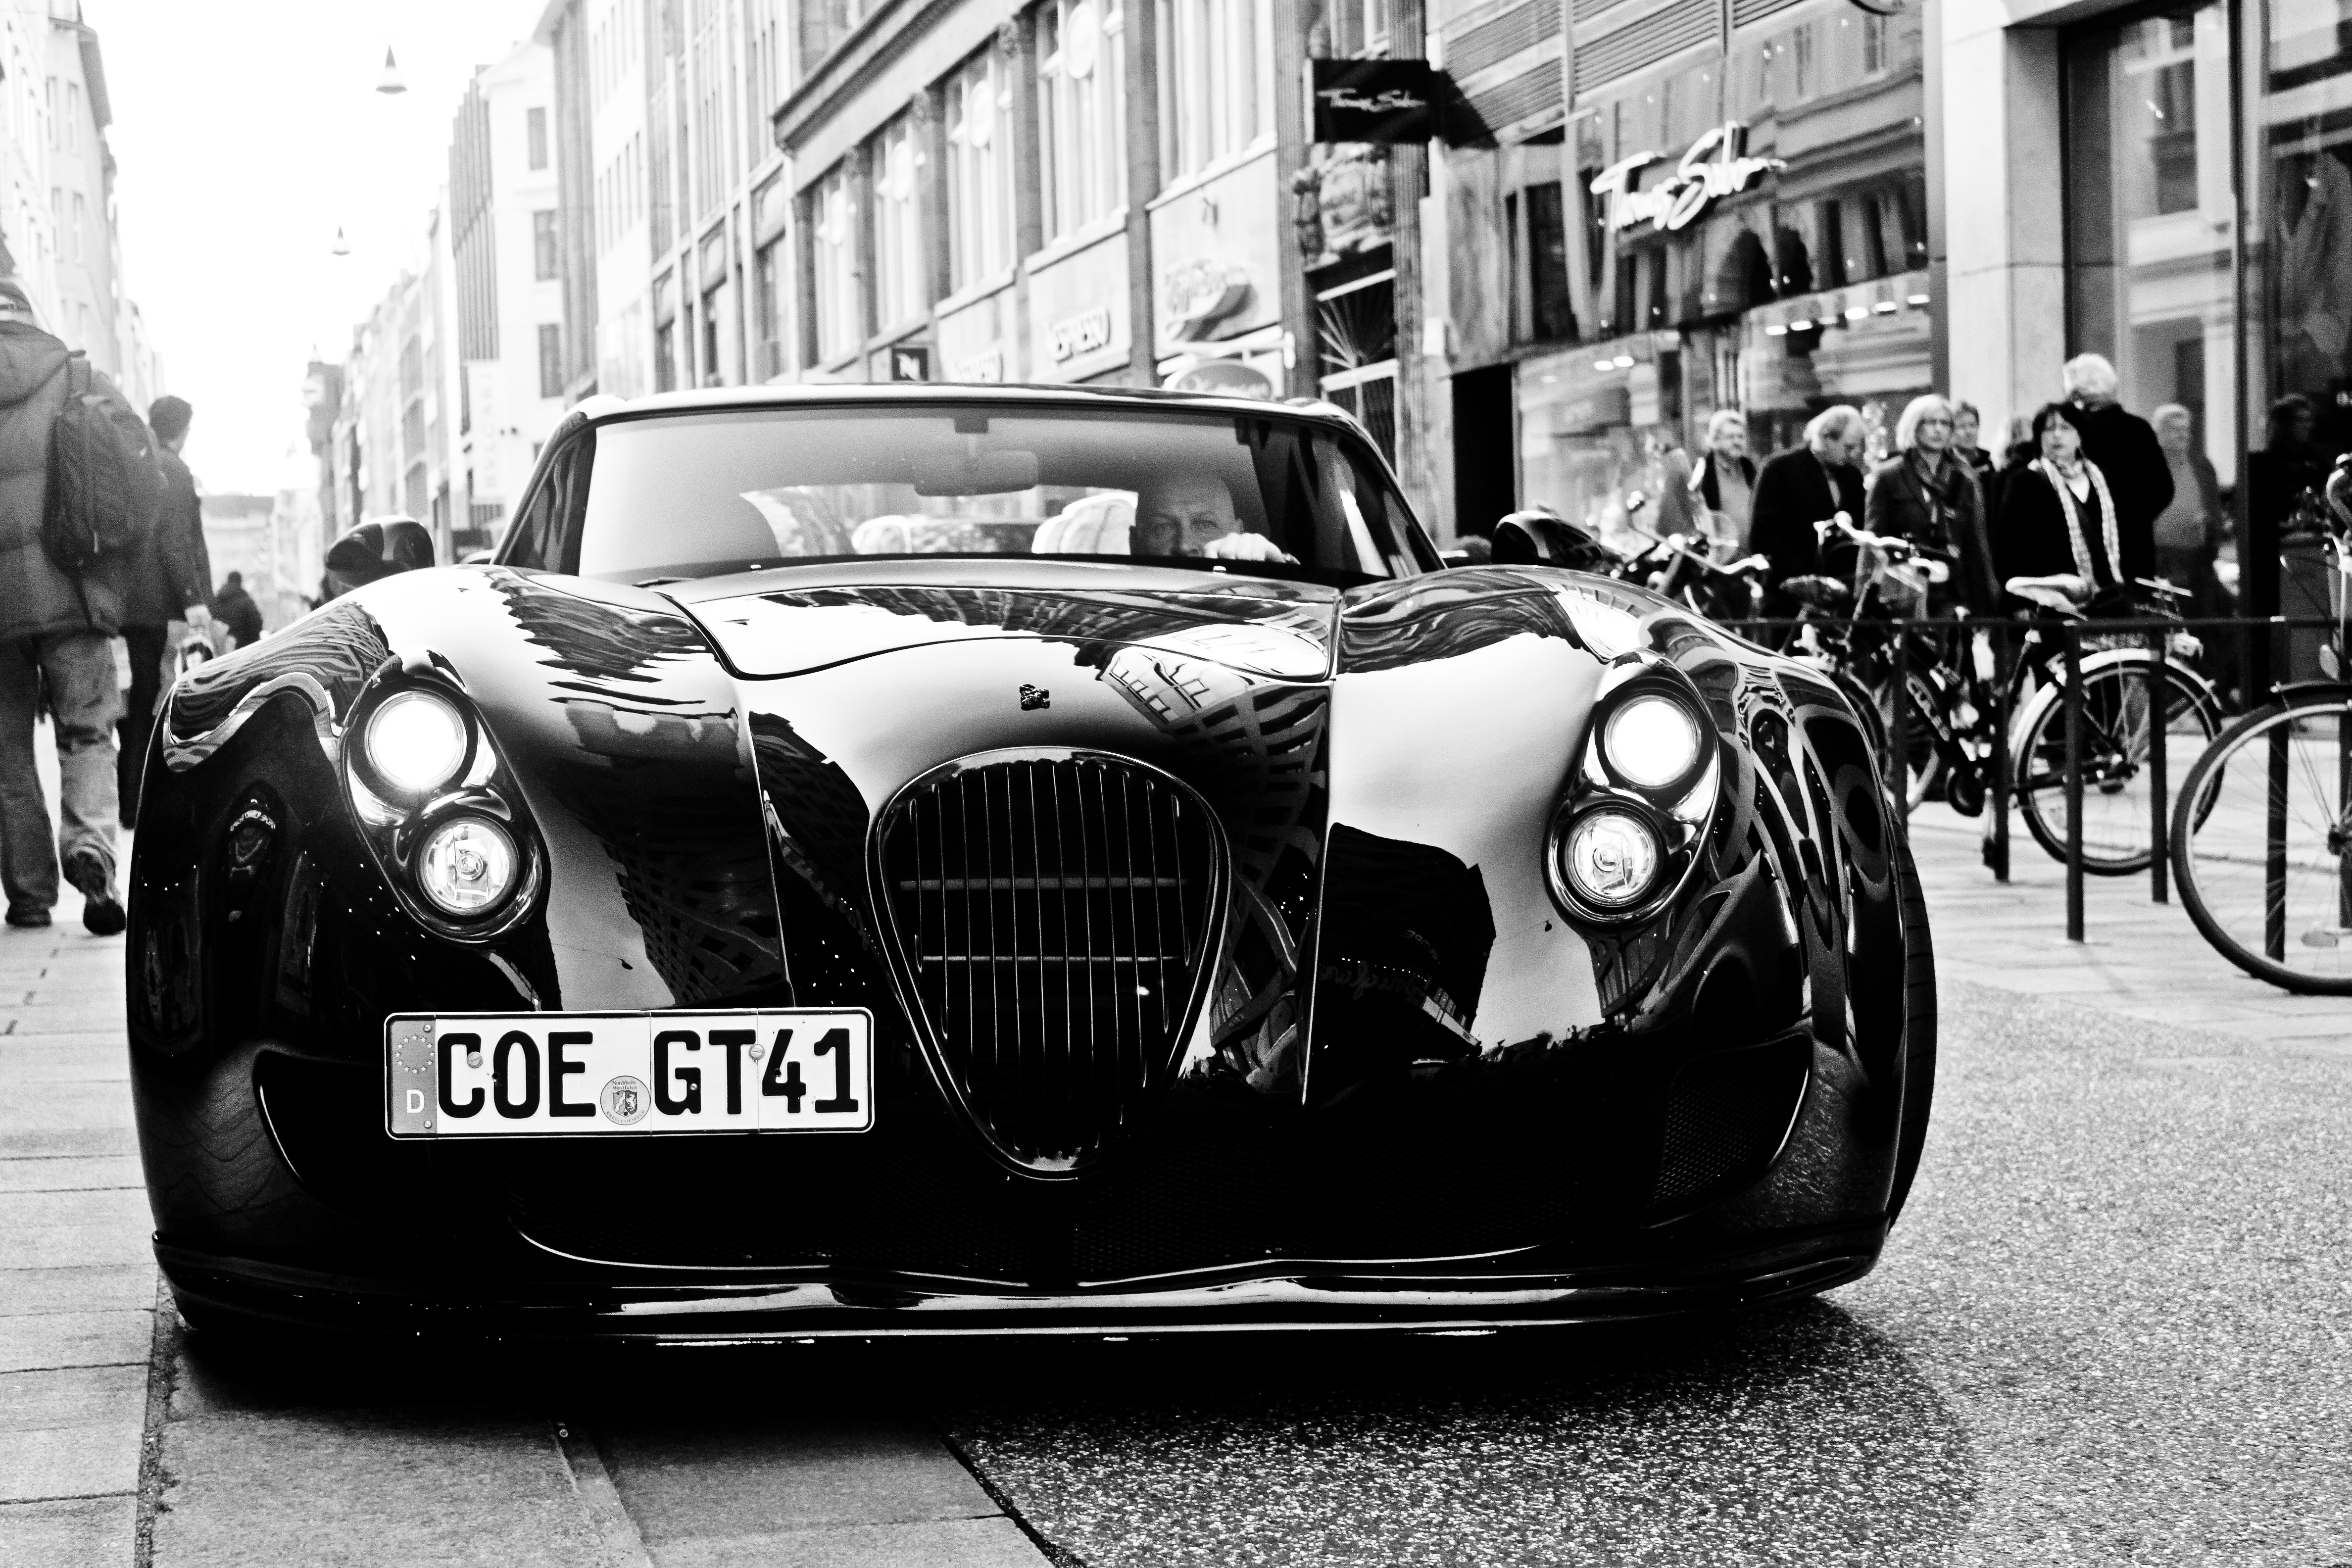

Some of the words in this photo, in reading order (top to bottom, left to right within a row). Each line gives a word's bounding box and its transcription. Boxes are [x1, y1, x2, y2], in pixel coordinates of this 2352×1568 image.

[406, 1089, 425, 1113] D
[438, 1030, 596, 1119] COE
[653, 1029, 859, 1115] GT41
